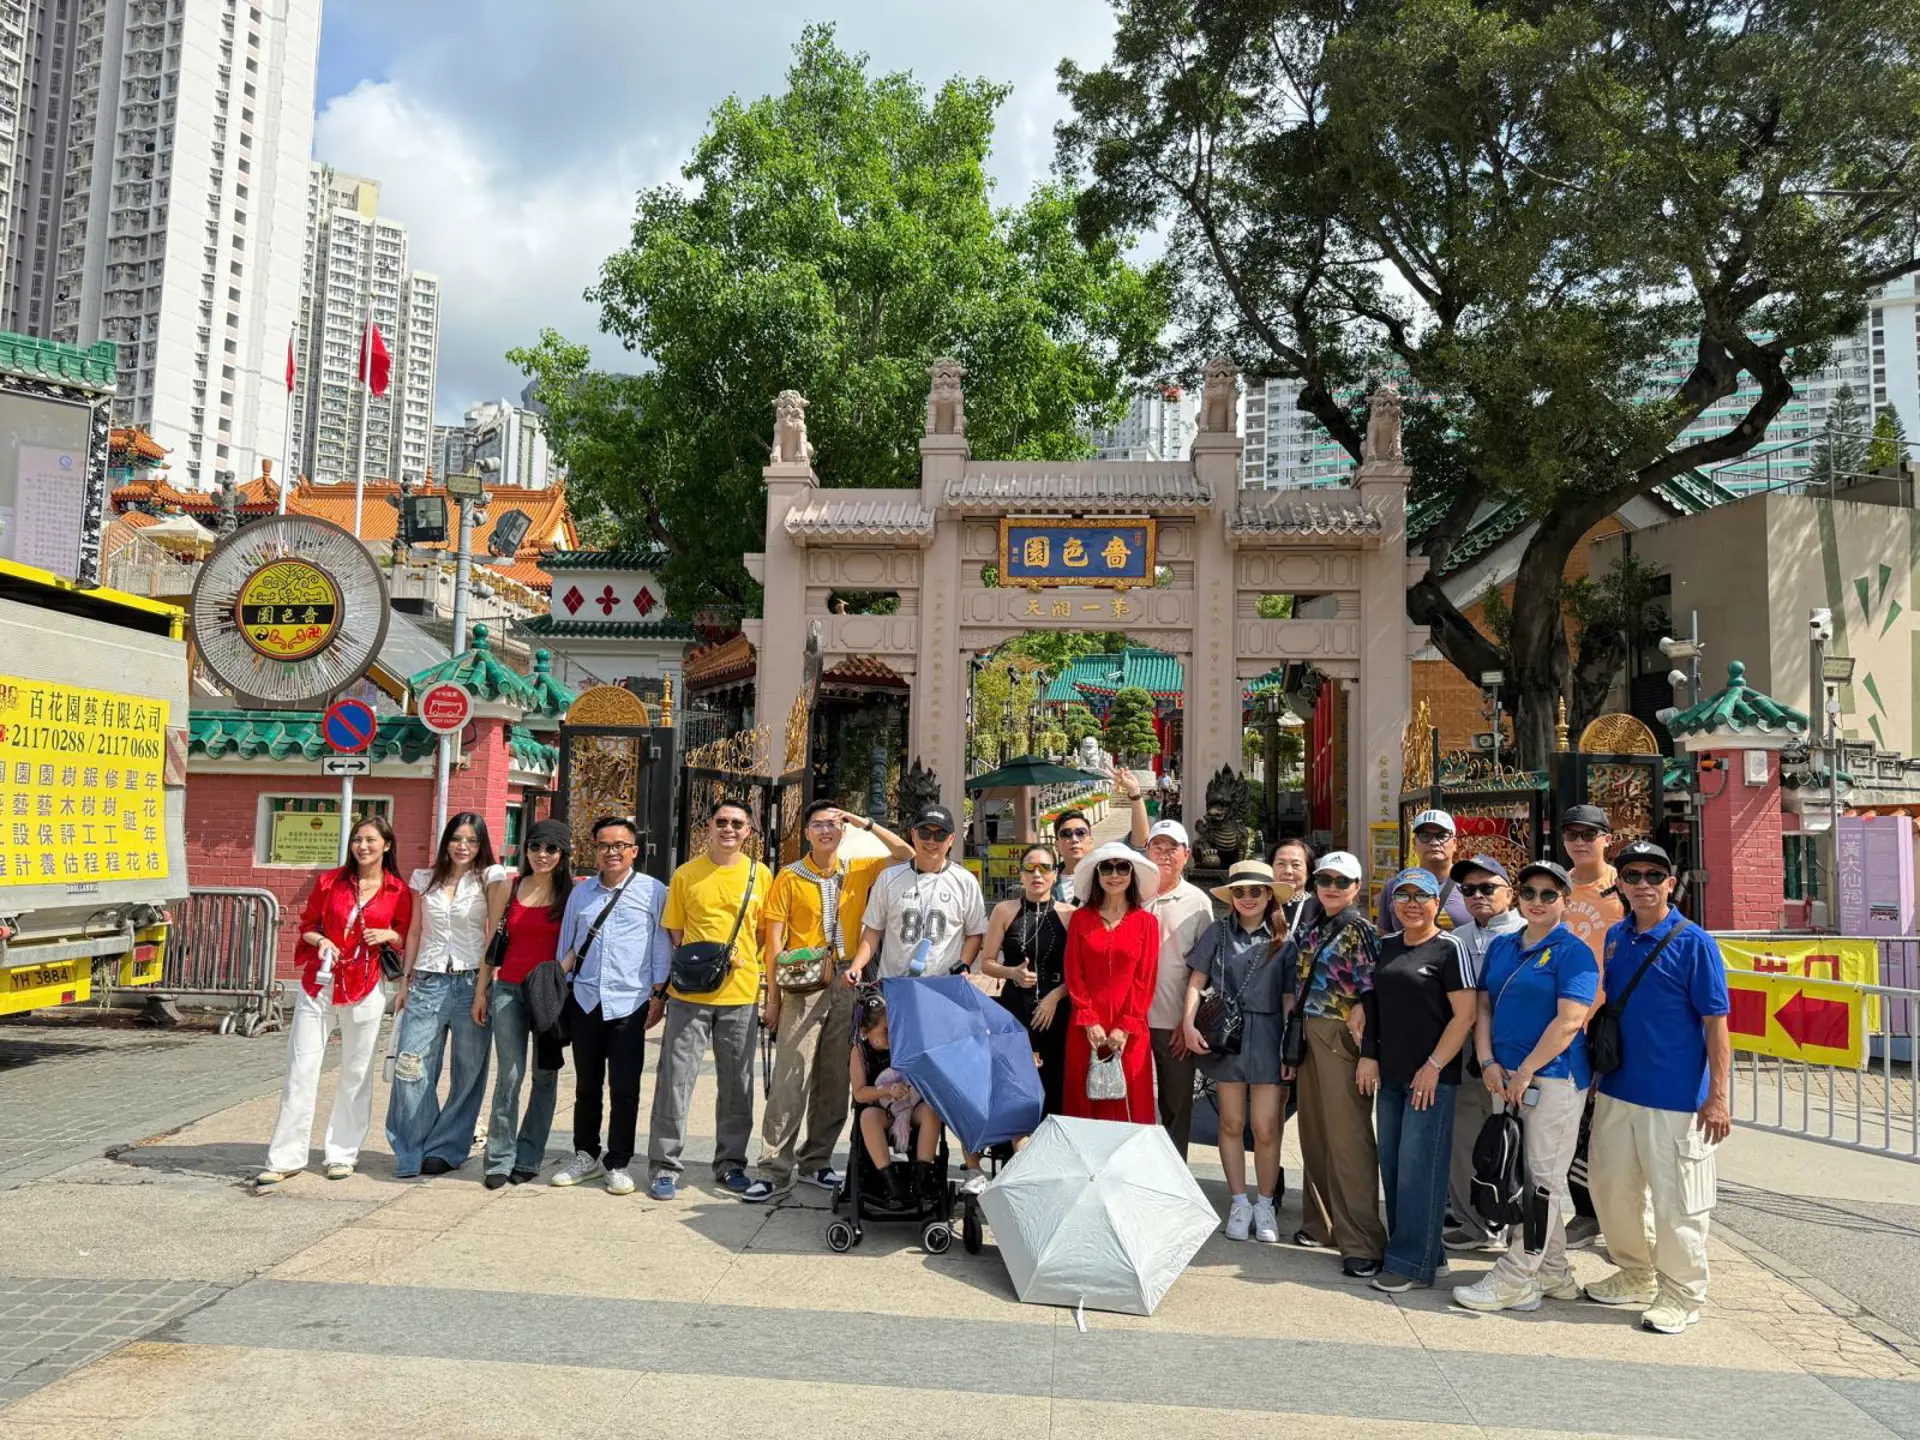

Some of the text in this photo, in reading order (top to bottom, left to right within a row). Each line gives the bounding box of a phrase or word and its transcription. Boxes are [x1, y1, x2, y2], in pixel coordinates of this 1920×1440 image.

[30, 689, 160, 733] 百花園藝有限公司
[900, 908, 947, 945] 80
[12, 967, 69, 990] YH 3884
